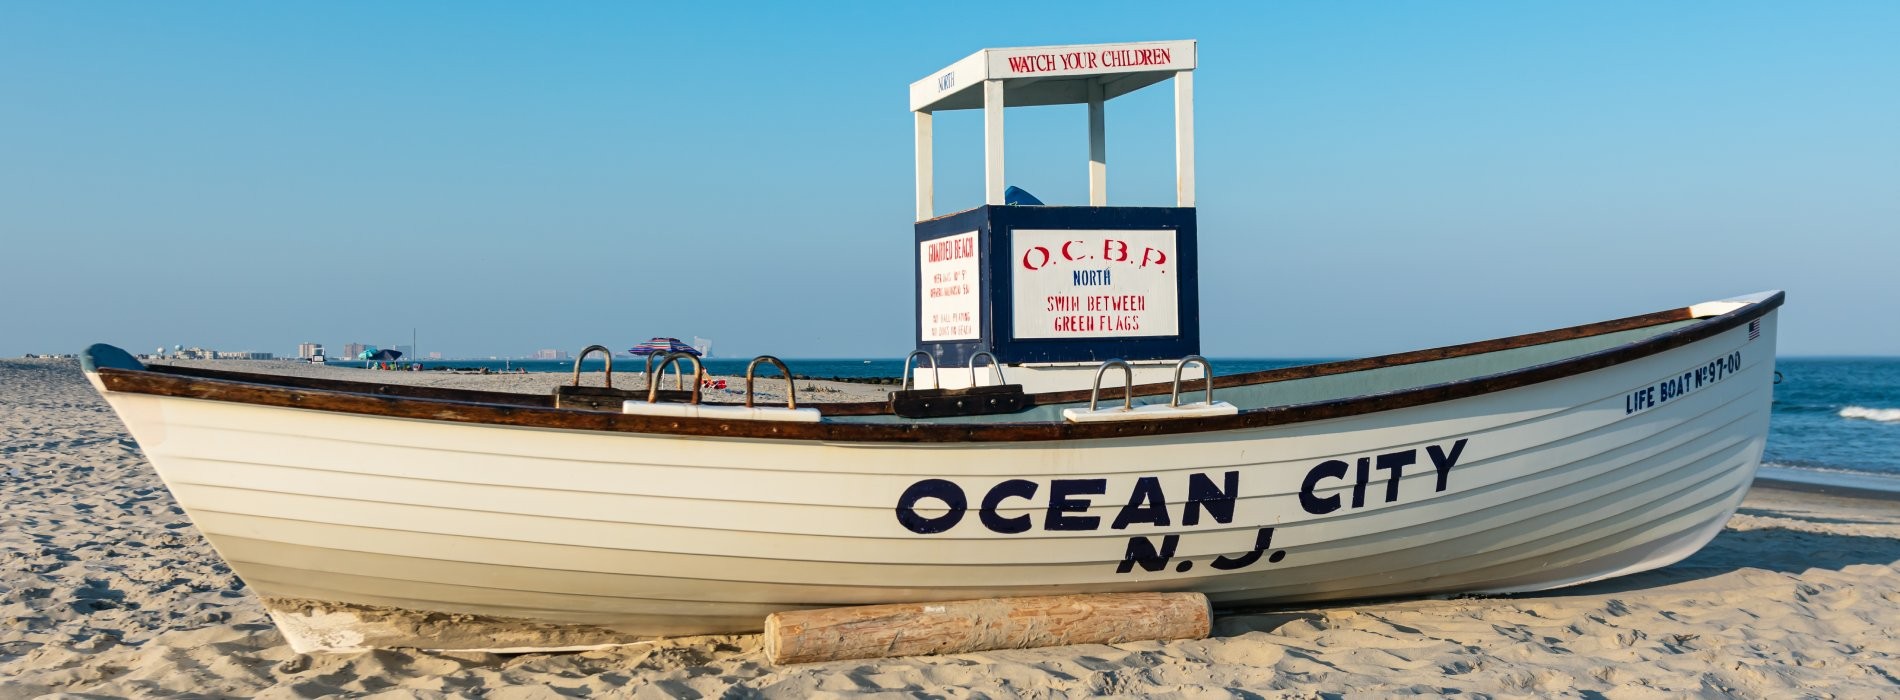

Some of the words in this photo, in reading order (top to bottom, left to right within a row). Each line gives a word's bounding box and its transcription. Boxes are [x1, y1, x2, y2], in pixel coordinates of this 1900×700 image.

[1008, 55, 1056, 73] WATCH
[1060, 52, 1097, 70] YOUR
[1102, 48, 1171, 67] CHILDREN
[938, 71, 955, 93] NORTH
[1073, 269, 1111, 286] NORTH
[1047, 295, 1080, 312] SWIM
[1087, 295, 1145, 312] BETWEEN
[1054, 315, 1095, 332] GREEN
[1099, 315, 1139, 332] FLAGS
[1626, 386, 1655, 415] LIFE
[1660, 372, 1692, 402] BOAT
[896, 470, 1240, 535] OCEAN
[1298, 438, 1468, 515] CITY
